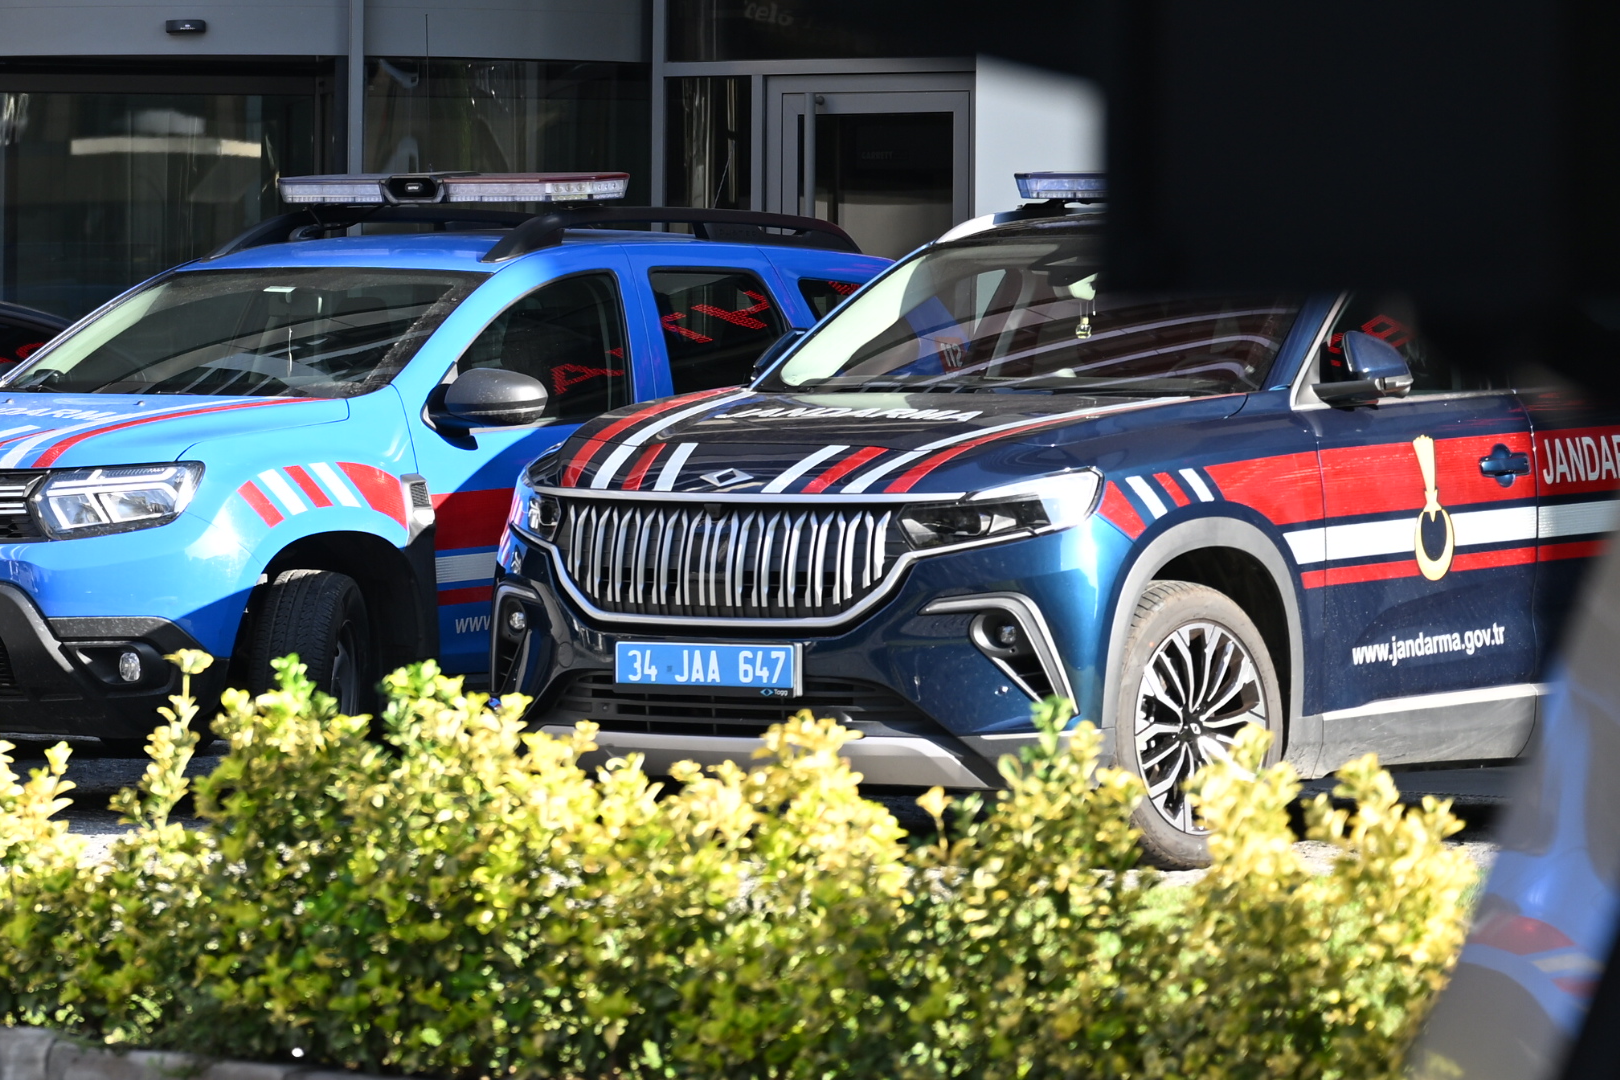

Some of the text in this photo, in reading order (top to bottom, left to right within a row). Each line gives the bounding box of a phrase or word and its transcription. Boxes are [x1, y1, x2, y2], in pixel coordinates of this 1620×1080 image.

[714, 408, 984, 423] JANDARMA
[1352, 622, 1506, 666] www.jandarma.gov.tr
[628, 650, 786, 684] 34 JAA 647
[774, 688, 788, 696] Togg
